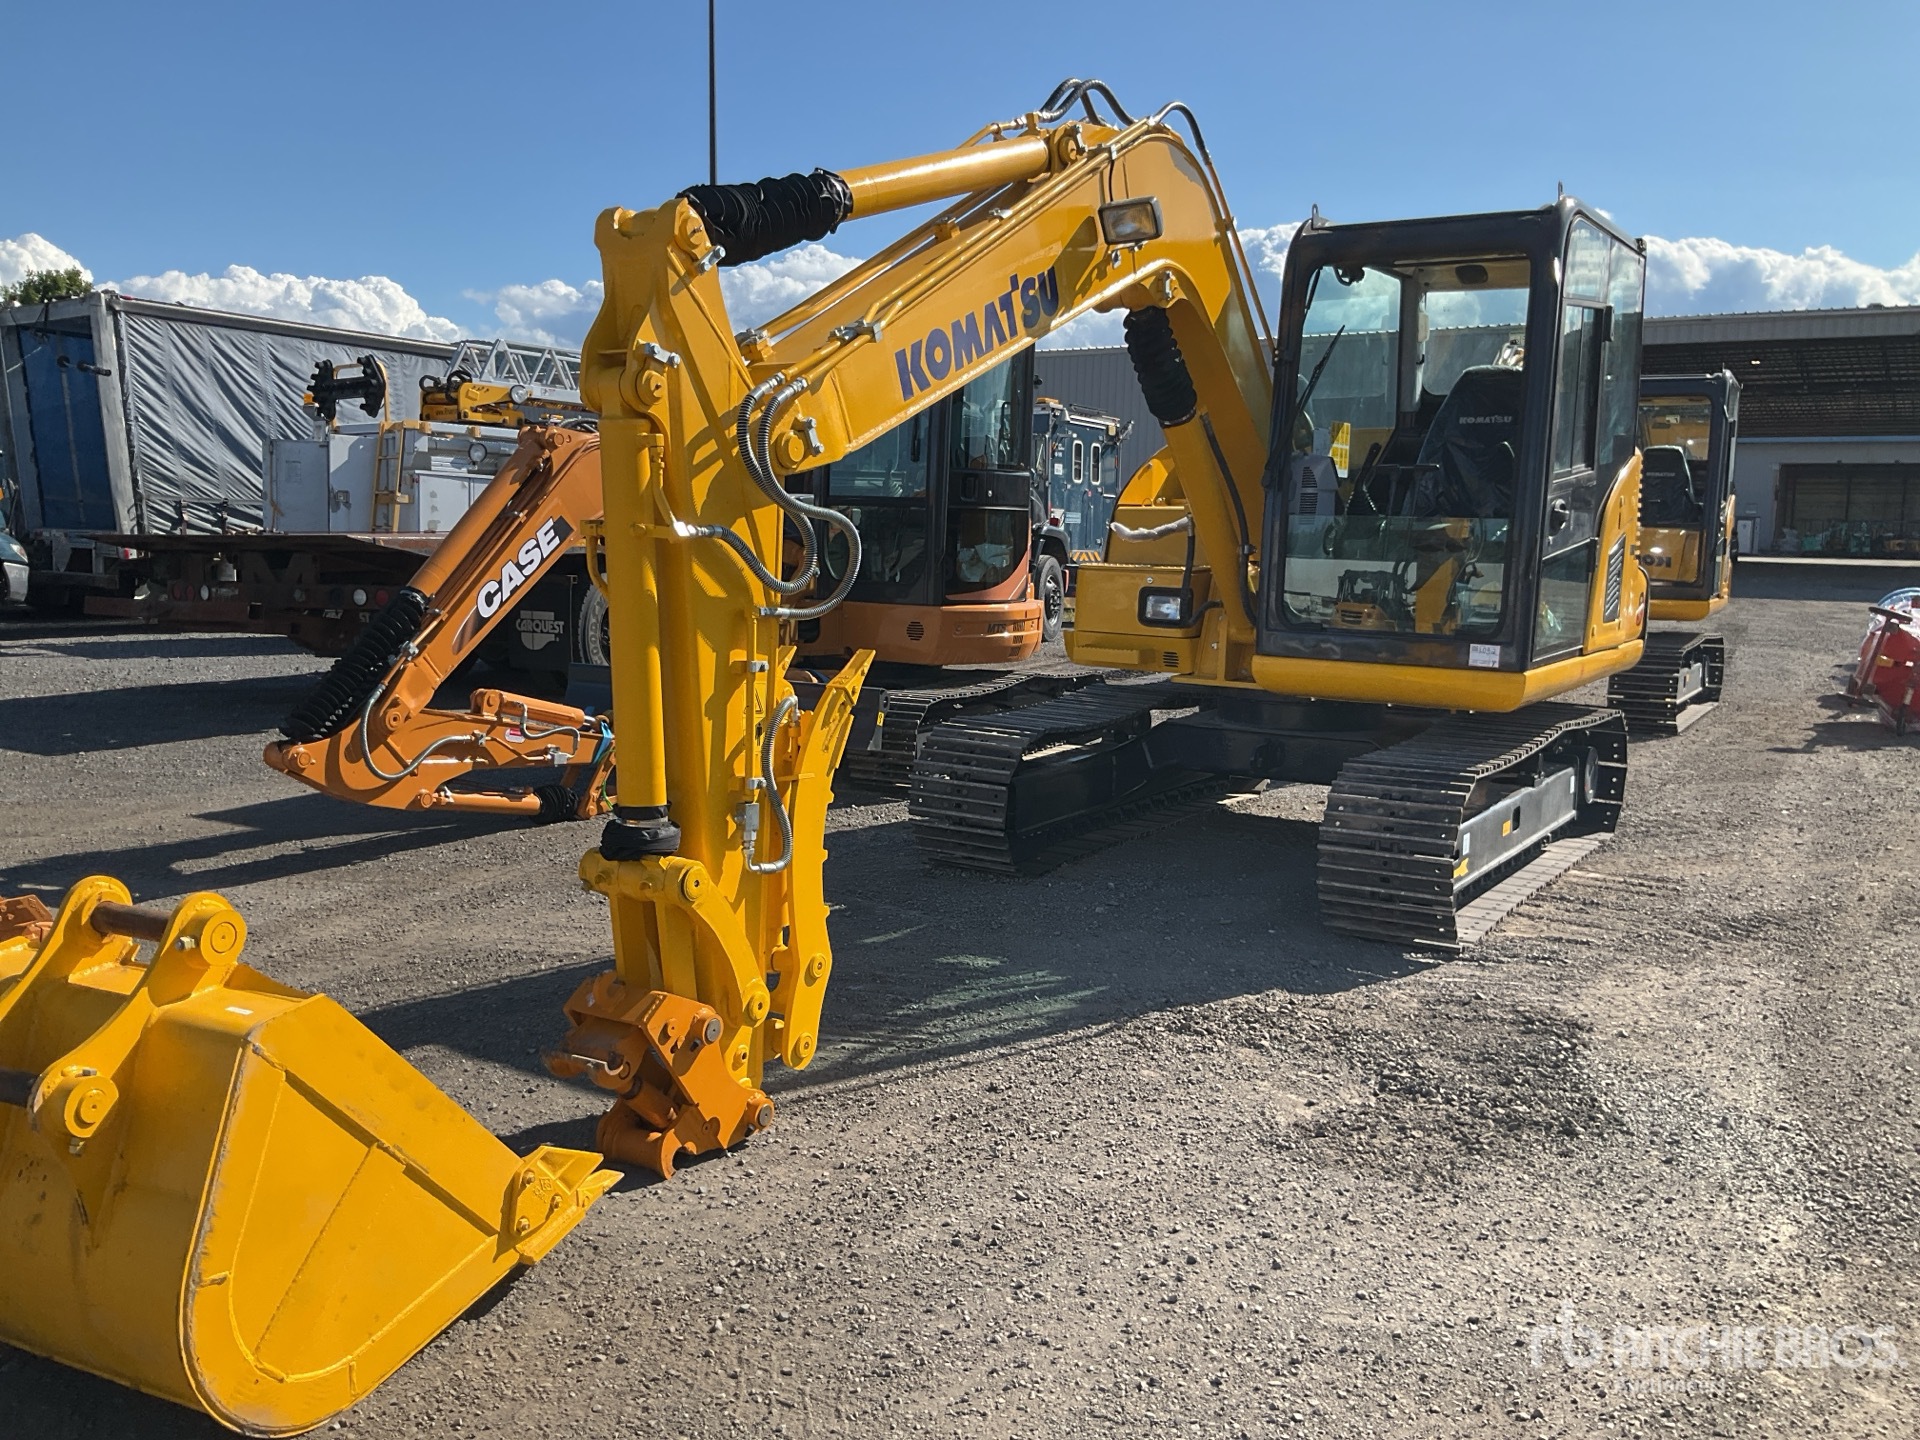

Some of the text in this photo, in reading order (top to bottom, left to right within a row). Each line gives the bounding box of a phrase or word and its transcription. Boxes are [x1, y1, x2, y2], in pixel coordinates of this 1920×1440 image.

[895, 265, 1060, 402] KOMATSU
[1459, 414, 1512, 424] KOMATSU
[477, 518, 560, 618] CASE
[516, 618, 565, 634] CARQUEST
